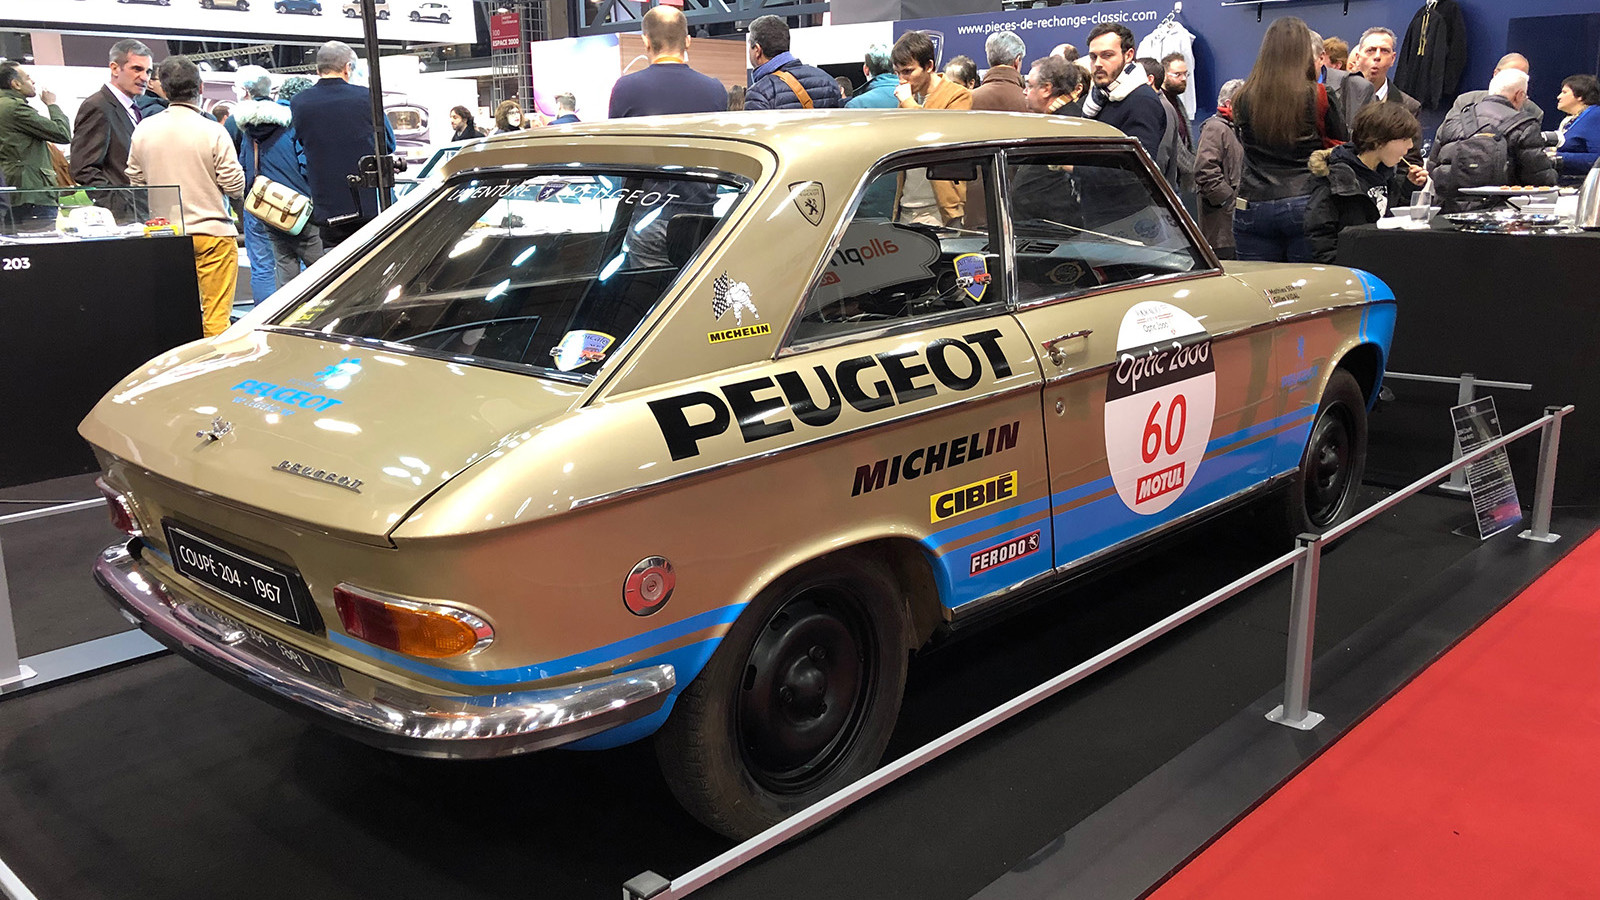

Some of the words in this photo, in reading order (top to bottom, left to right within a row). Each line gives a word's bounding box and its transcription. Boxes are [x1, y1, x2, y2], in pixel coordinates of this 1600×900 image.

[957, 11, 1157, 35] www.pieces-de-rechange-classic.com
[508, 38, 520, 46] 2000
[2, 257, 31, 270] 203
[710, 325, 769, 342] MICHELIN
[1116, 346, 1168, 391] Optic
[1169, 341, 1210, 371] 2000
[230, 379, 344, 413] PEUGEOT
[646, 328, 1013, 462] PEUGEOT
[1141, 394, 1187, 464] 60
[278, 460, 364, 489] PEUGEOT
[851, 421, 1020, 497] MICHELIN
[1138, 467, 1182, 500] MOTUL
[971, 539, 1026, 573] FERODO
[180, 545, 219, 577] COUPÉ
[218, 562, 241, 587] 204
[251, 576, 280, 604] 1967
